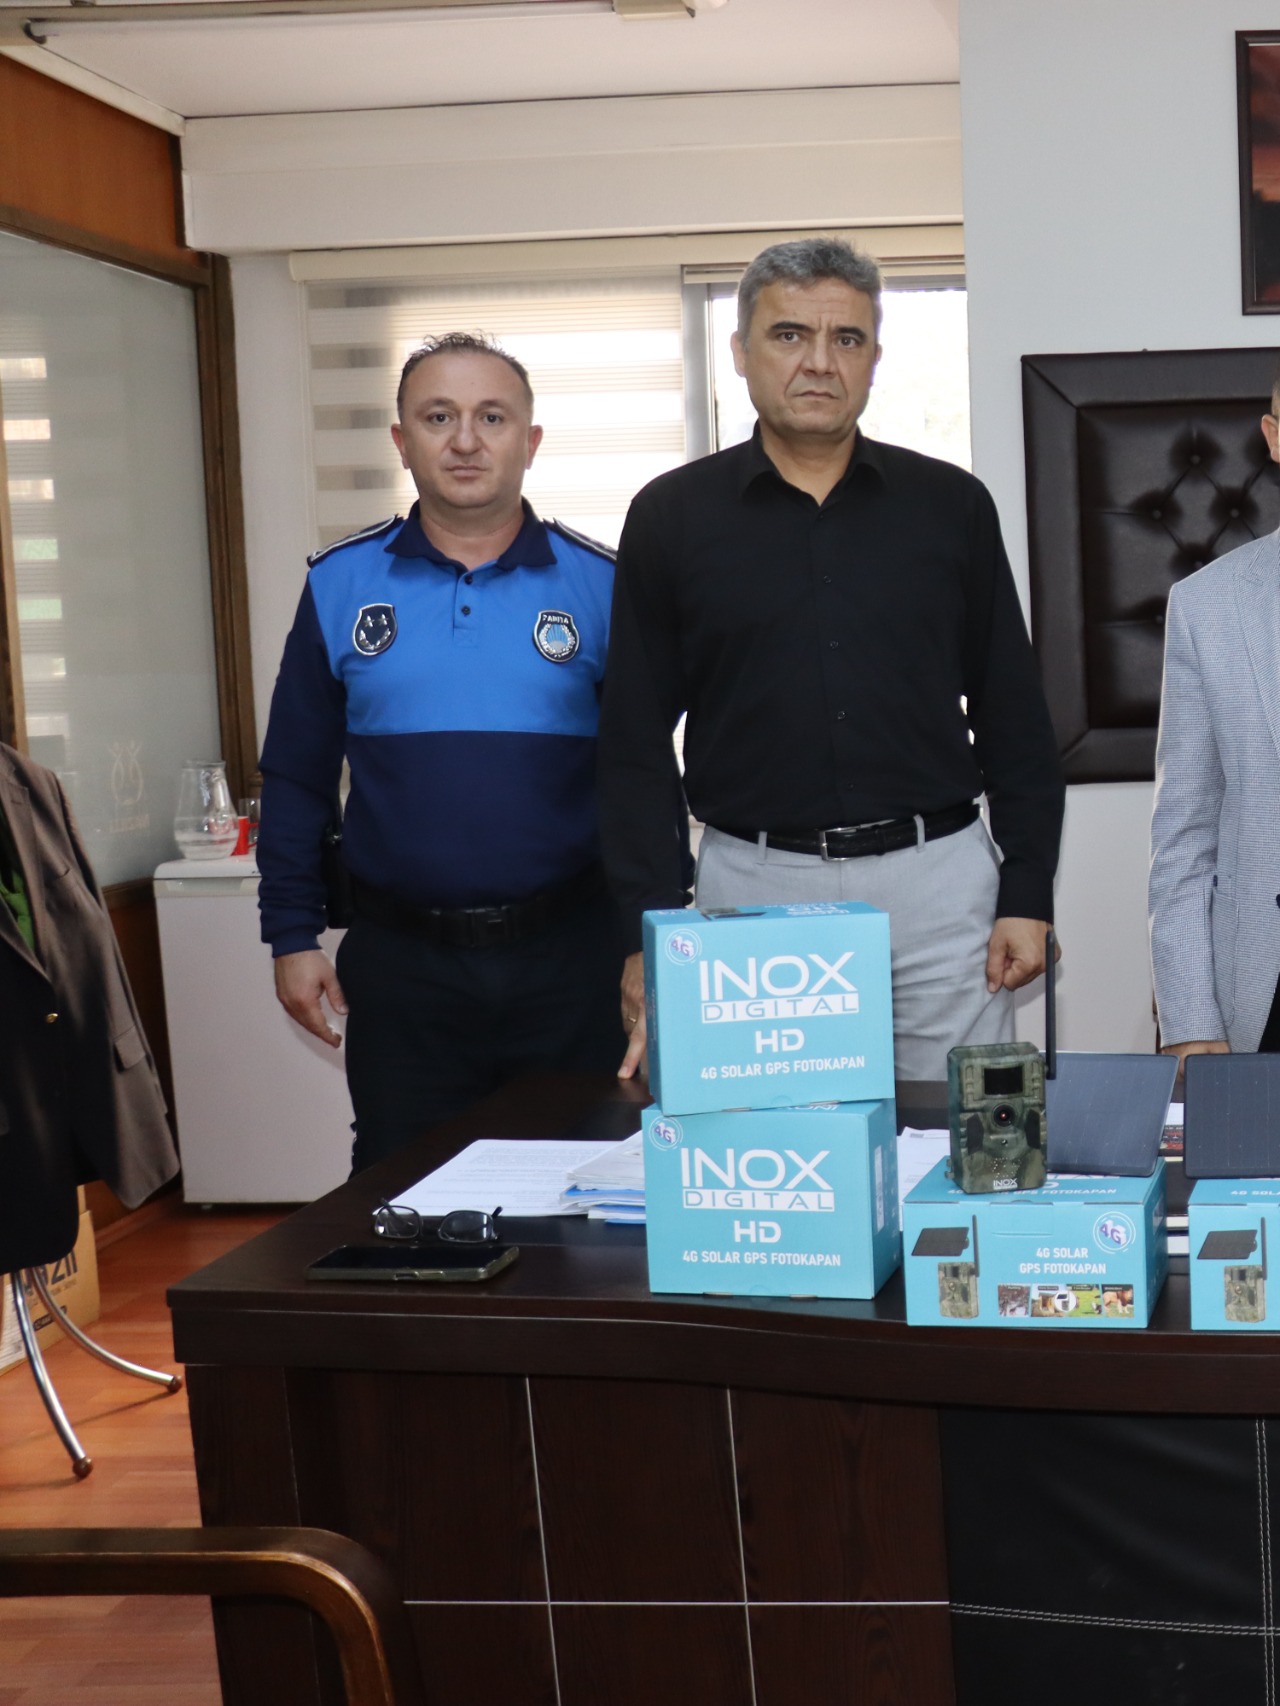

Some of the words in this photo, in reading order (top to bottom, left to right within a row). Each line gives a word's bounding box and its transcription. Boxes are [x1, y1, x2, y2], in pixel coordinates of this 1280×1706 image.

[671, 935, 694, 957] 4G
[700, 952, 858, 1000] INOX
[704, 996, 857, 1021] DIGITAL
[755, 1028, 805, 1053] HD
[701, 1067, 717, 1079] 4G
[721, 1064, 762, 1078] SOLAR
[766, 1062, 790, 1074] GPS
[794, 1056, 865, 1072] FOTOKAPAN
[654, 1122, 676, 1143] 4G
[681, 1148, 834, 1190] INOX
[993, 1178, 1017, 1186] INOX
[685, 1191, 833, 1210] DIGITAL
[734, 1220, 782, 1243] HD
[1100, 1220, 1126, 1245] 4G
[683, 1251, 698, 1262] 4G
[702, 1251, 740, 1263] SOLAR
[744, 1253, 767, 1264] GPS
[771, 1253, 841, 1266] FOTOKAPAN
[1036, 1248, 1050, 1258] 4G
[1054, 1248, 1088, 1259] SOLAR
[1020, 1263, 1040, 1274] GPS
[1044, 1263, 1106, 1274] FOTOKAPAN
